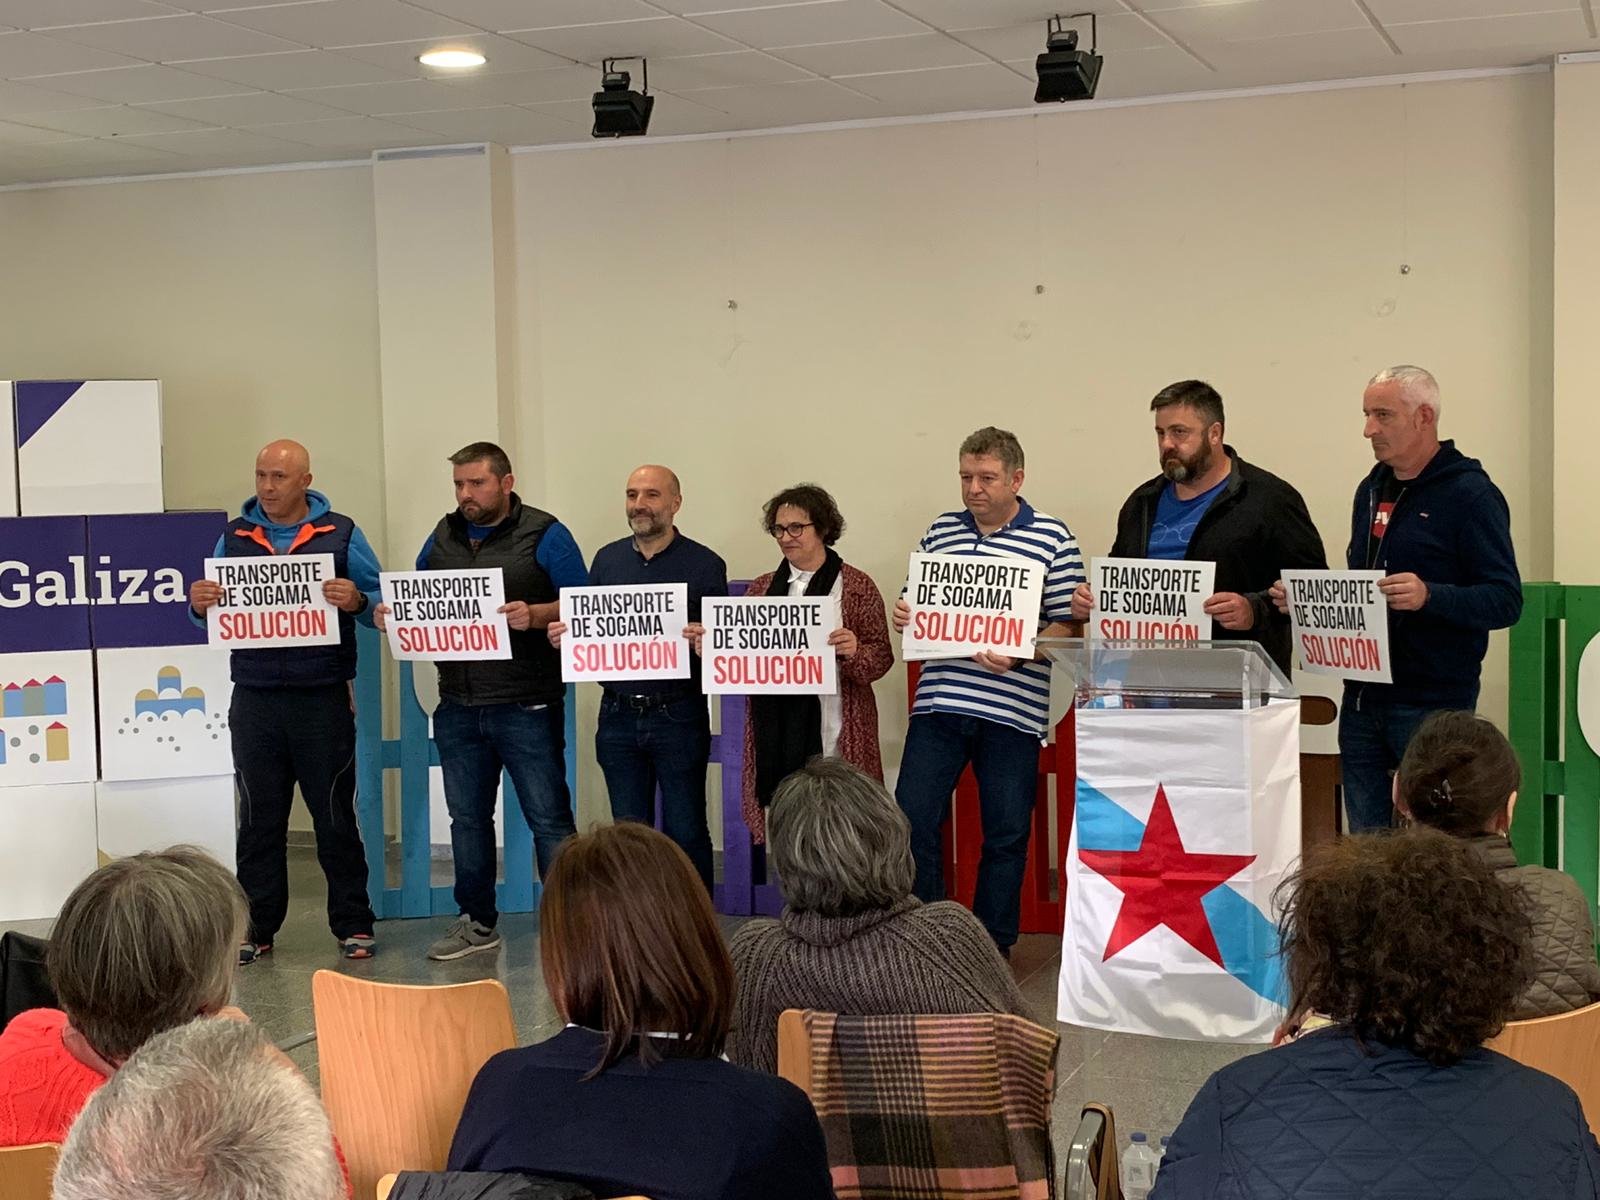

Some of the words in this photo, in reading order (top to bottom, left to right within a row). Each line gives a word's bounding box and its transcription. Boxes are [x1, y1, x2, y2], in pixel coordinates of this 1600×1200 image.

[0, 556, 187, 608] Galiza
[215, 562, 322, 586] TRANSPORTE
[920, 561, 1030, 589] TRANSPORTE
[1100, 566, 1201, 593] TRANSPORTE
[243, 584, 312, 606] SOGAMA
[391, 577, 492, 600] TRANSPORTE
[916, 584, 938, 605] DE
[941, 585, 1013, 611] SOGAMA
[1290, 579, 1375, 604] TRANSPORTE
[394, 602, 413, 622] DE
[417, 599, 482, 620] SOGAMA
[570, 592, 674, 616] TRANSPORTE
[713, 604, 821, 627] TRANSPORTE
[1100, 590, 1119, 613] DE
[1122, 591, 1187, 617] SOGAMA
[219, 605, 327, 640] SOLUCIÓN
[571, 618, 591, 638] DE
[596, 616, 664, 637] SOGAMA
[913, 611, 1024, 647] SOLUCIÓN
[1294, 604, 1311, 628] DE
[1312, 605, 1366, 631] SOGAMA
[397, 620, 499, 653] SOLUCIÓN
[713, 629, 734, 650] DE
[738, 628, 809, 650] SOGAMA
[572, 636, 678, 673] SOLUCIÓN
[1301, 632, 1381, 671] SOLUCIÓN
[713, 650, 823, 685] SOLUCIÓN
